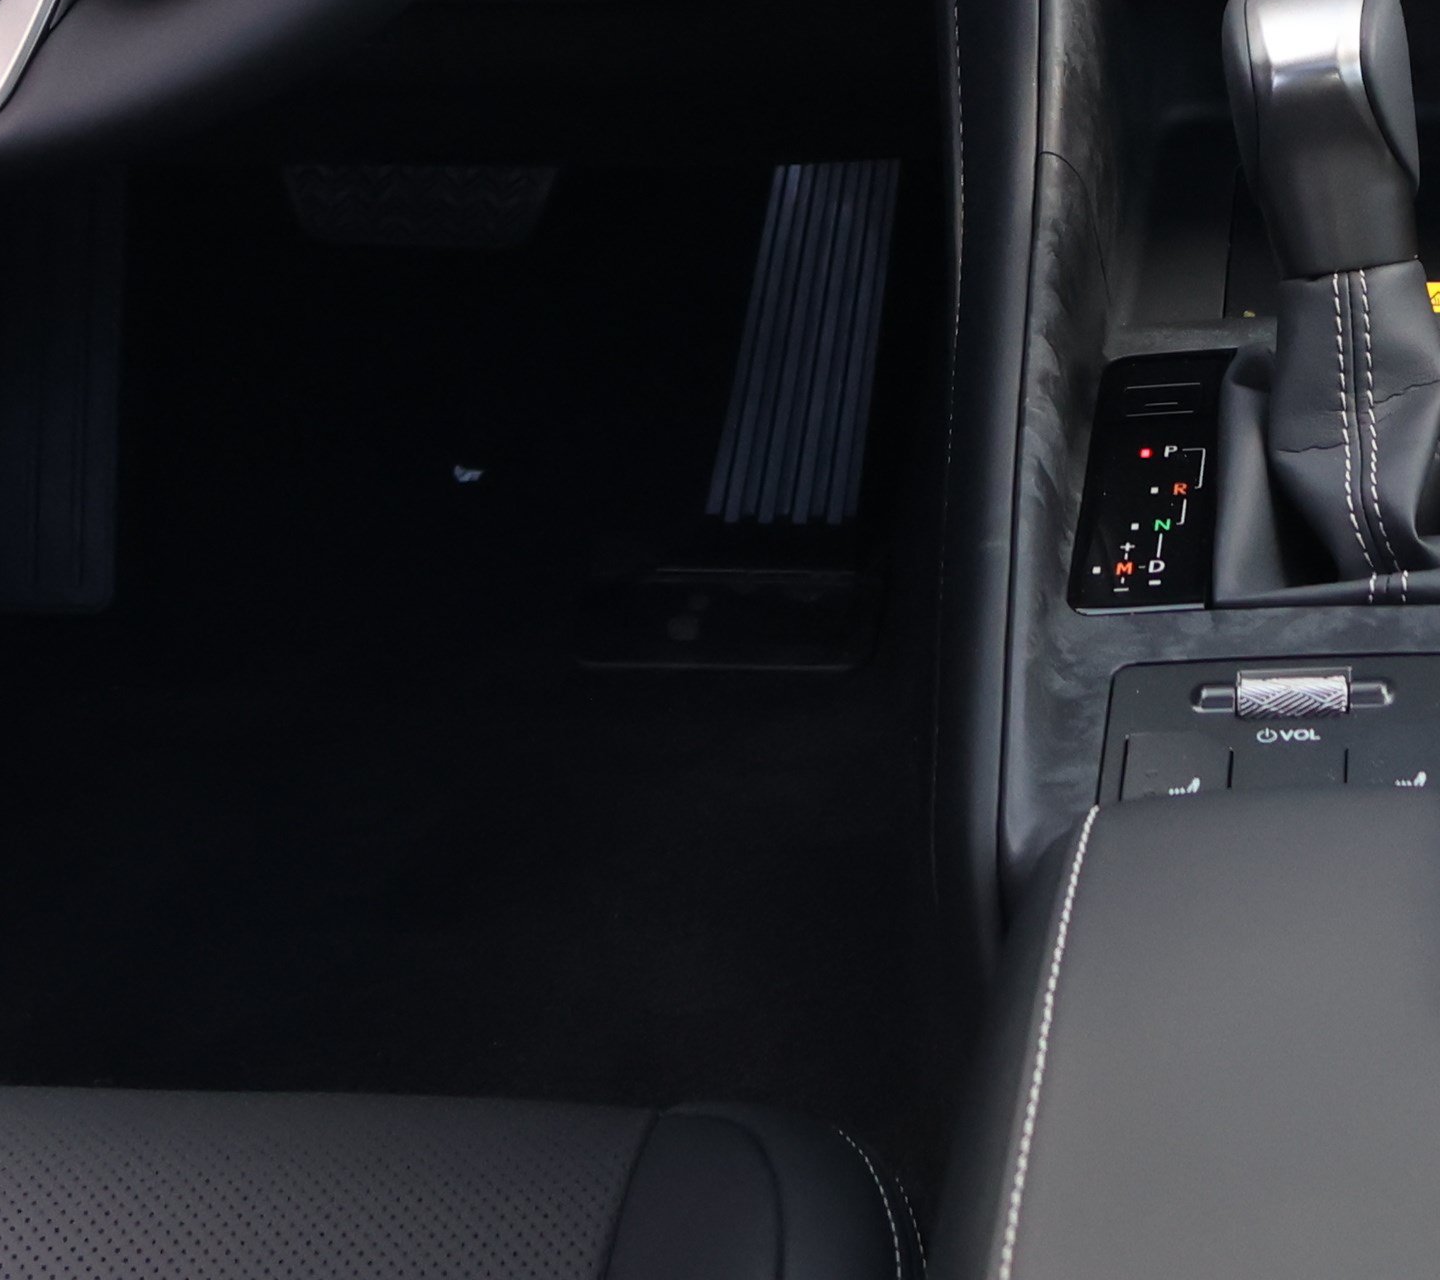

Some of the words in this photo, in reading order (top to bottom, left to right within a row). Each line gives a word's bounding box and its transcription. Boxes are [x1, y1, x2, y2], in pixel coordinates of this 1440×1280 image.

[1164, 445, 1178, 458] P
[1173, 482, 1188, 496] R
[1154, 518, 1171, 531] N
[1116, 562, 1134, 576] M
[1148, 559, 1166, 574] D
[1279, 727, 1321, 742] VOL
